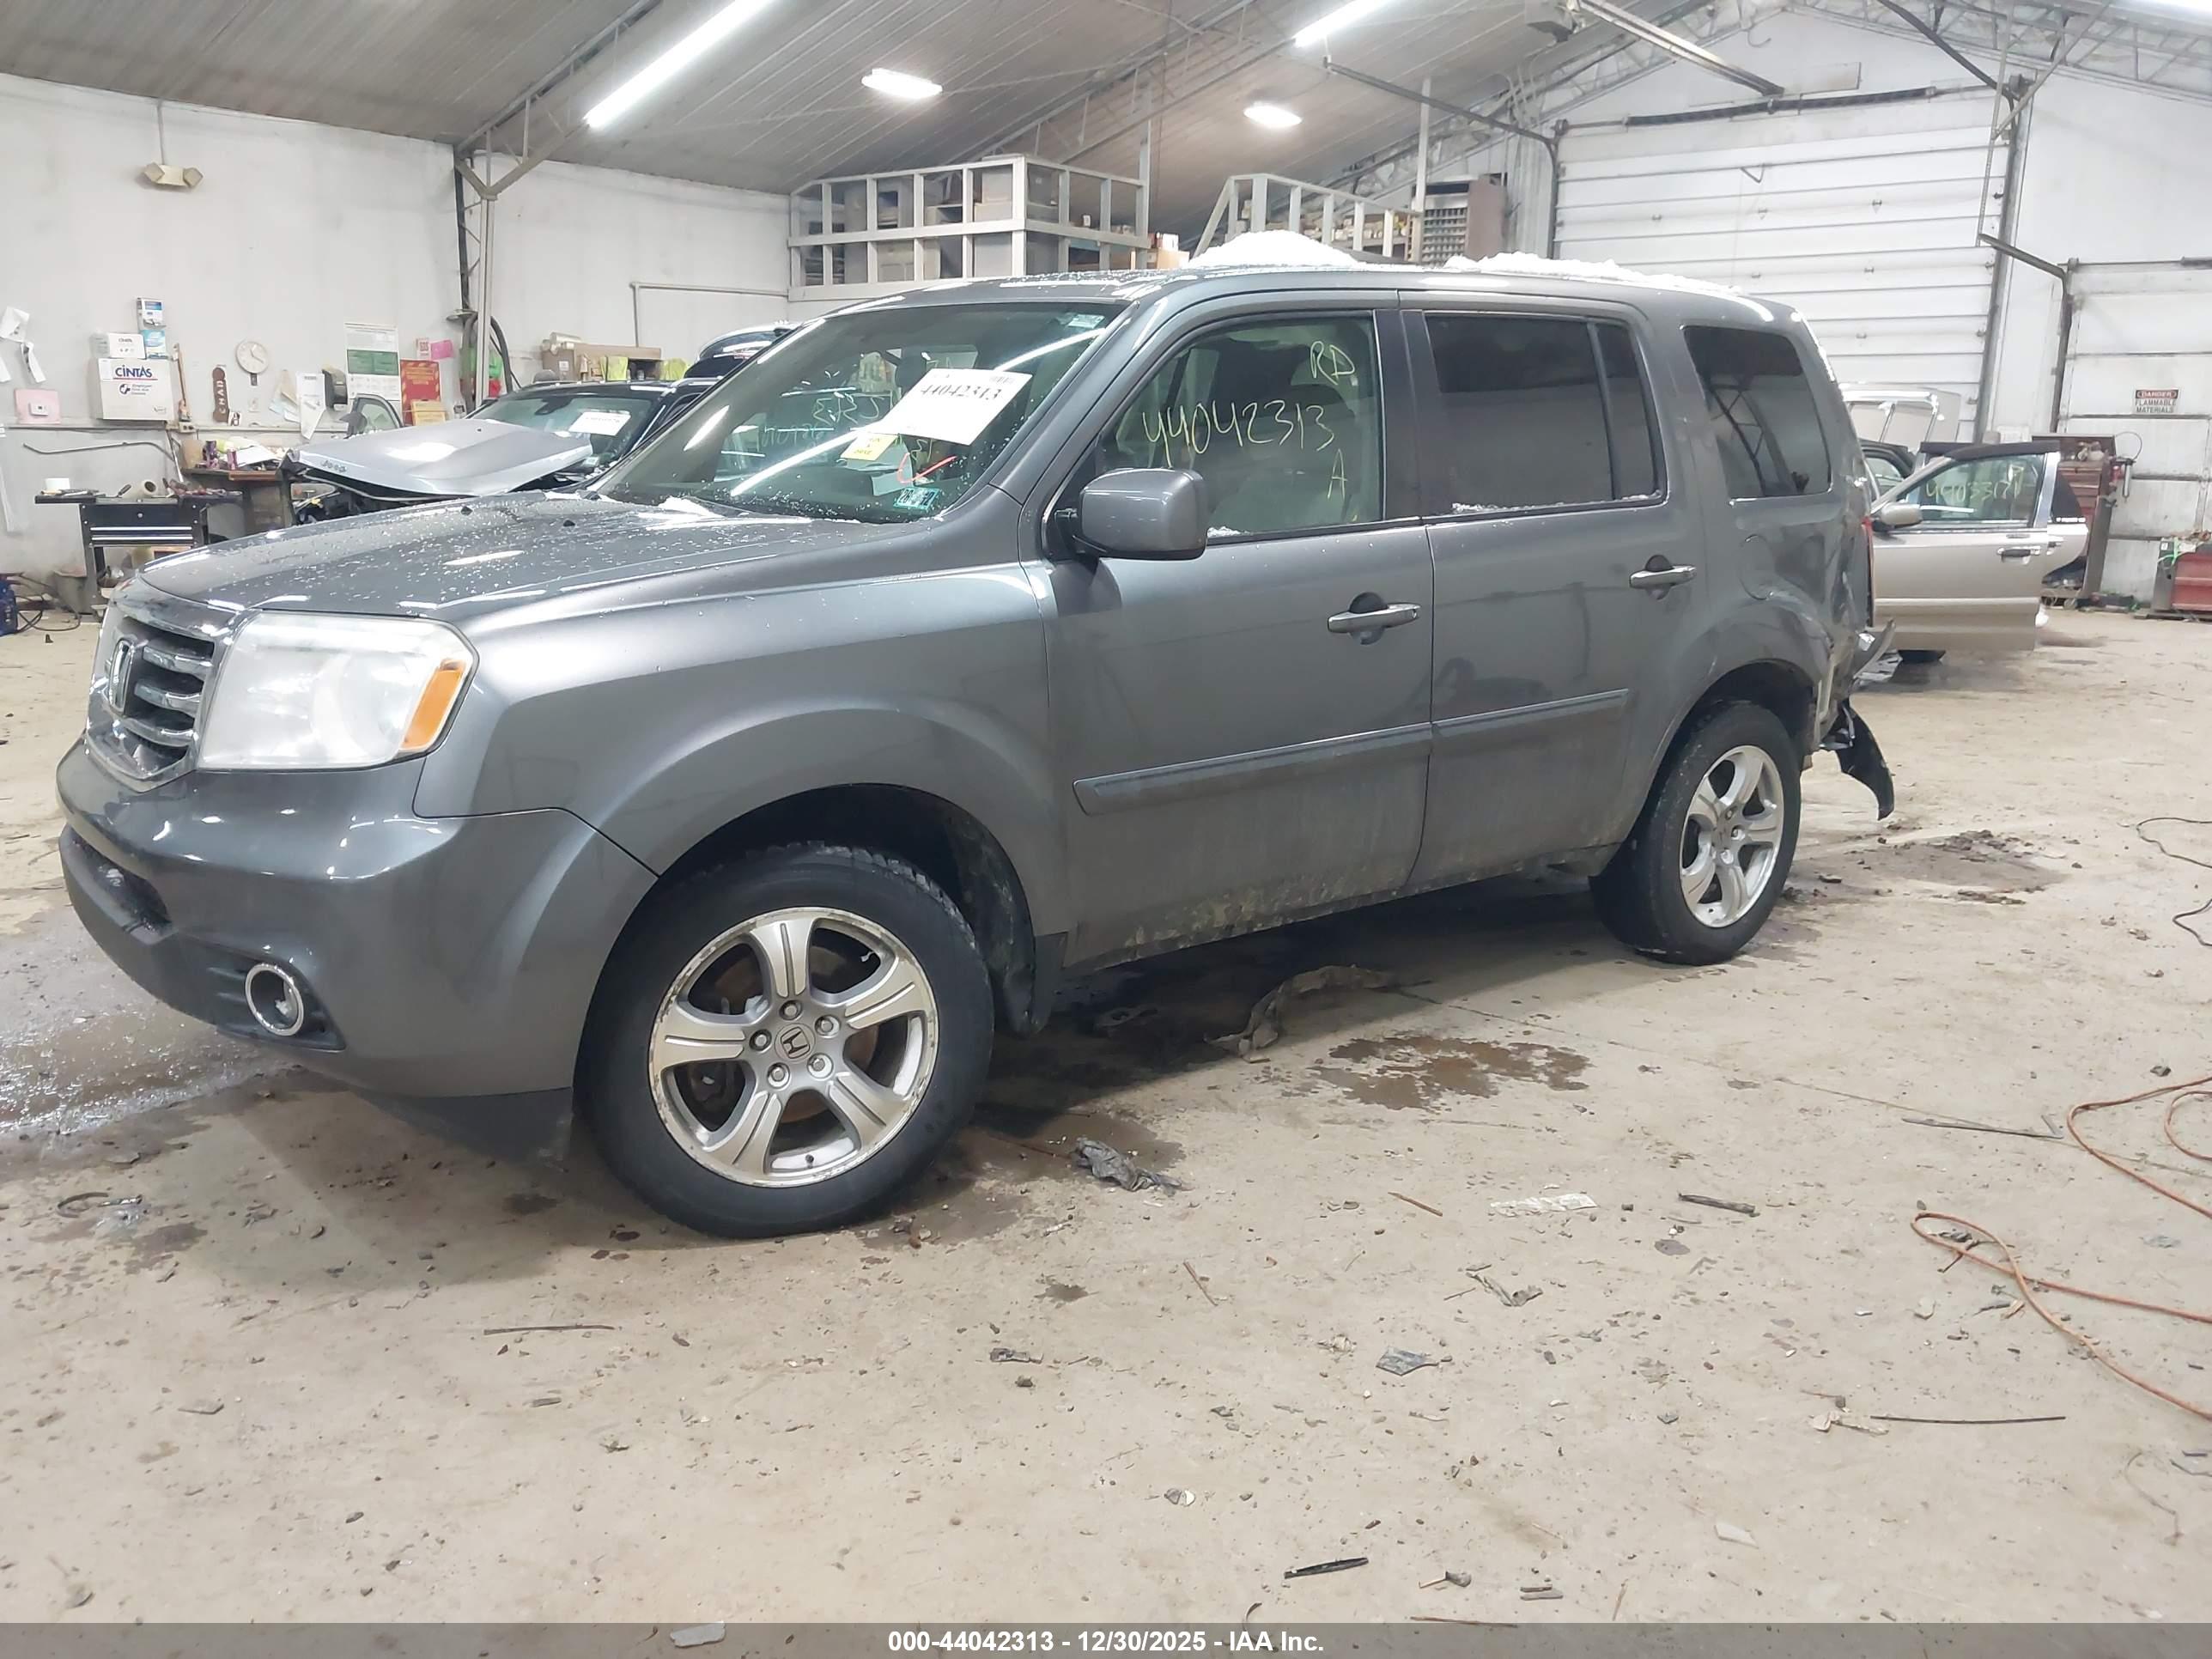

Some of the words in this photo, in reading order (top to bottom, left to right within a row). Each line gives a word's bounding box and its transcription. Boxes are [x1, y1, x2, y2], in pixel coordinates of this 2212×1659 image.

[115, 365, 153, 378] CINTAS
[1310, 341, 1356, 386] RD
[921, 384, 1003, 400] 44042313
[1142, 399, 1335, 468] 44042313
[1328, 447, 1348, 501] A
